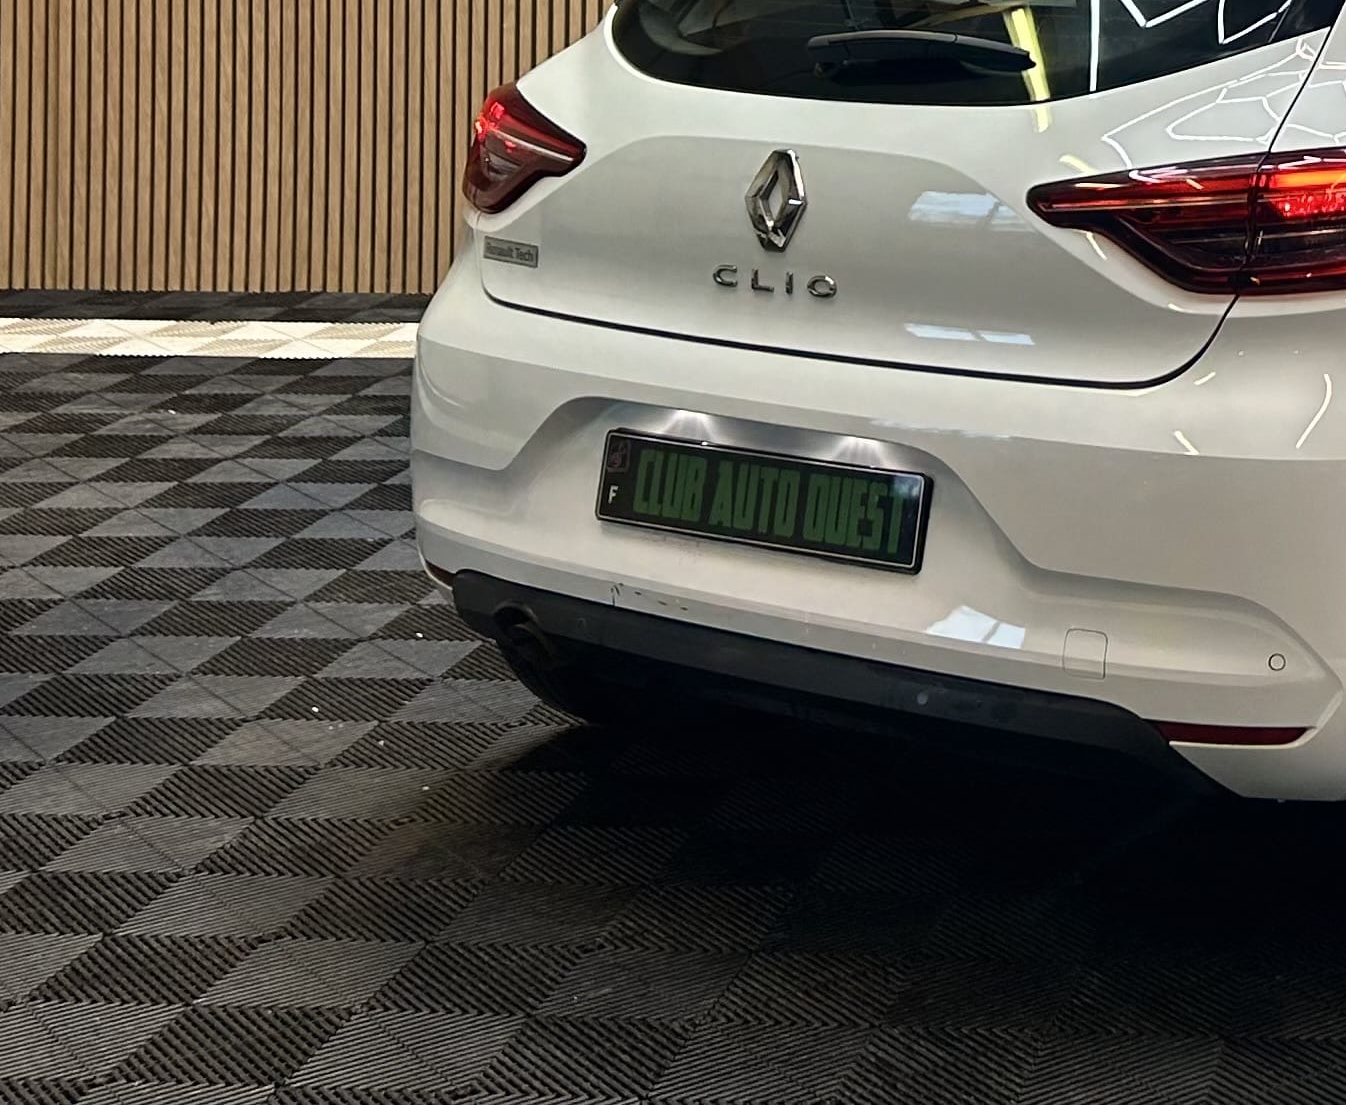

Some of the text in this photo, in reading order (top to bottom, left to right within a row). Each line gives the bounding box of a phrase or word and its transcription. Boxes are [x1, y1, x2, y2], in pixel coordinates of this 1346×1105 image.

[515, 246, 534, 262] Tech
[712, 264, 838, 298] CLIO
[608, 485, 619, 504] F
[633, 449, 908, 554] CLUB AUTO OUEST
